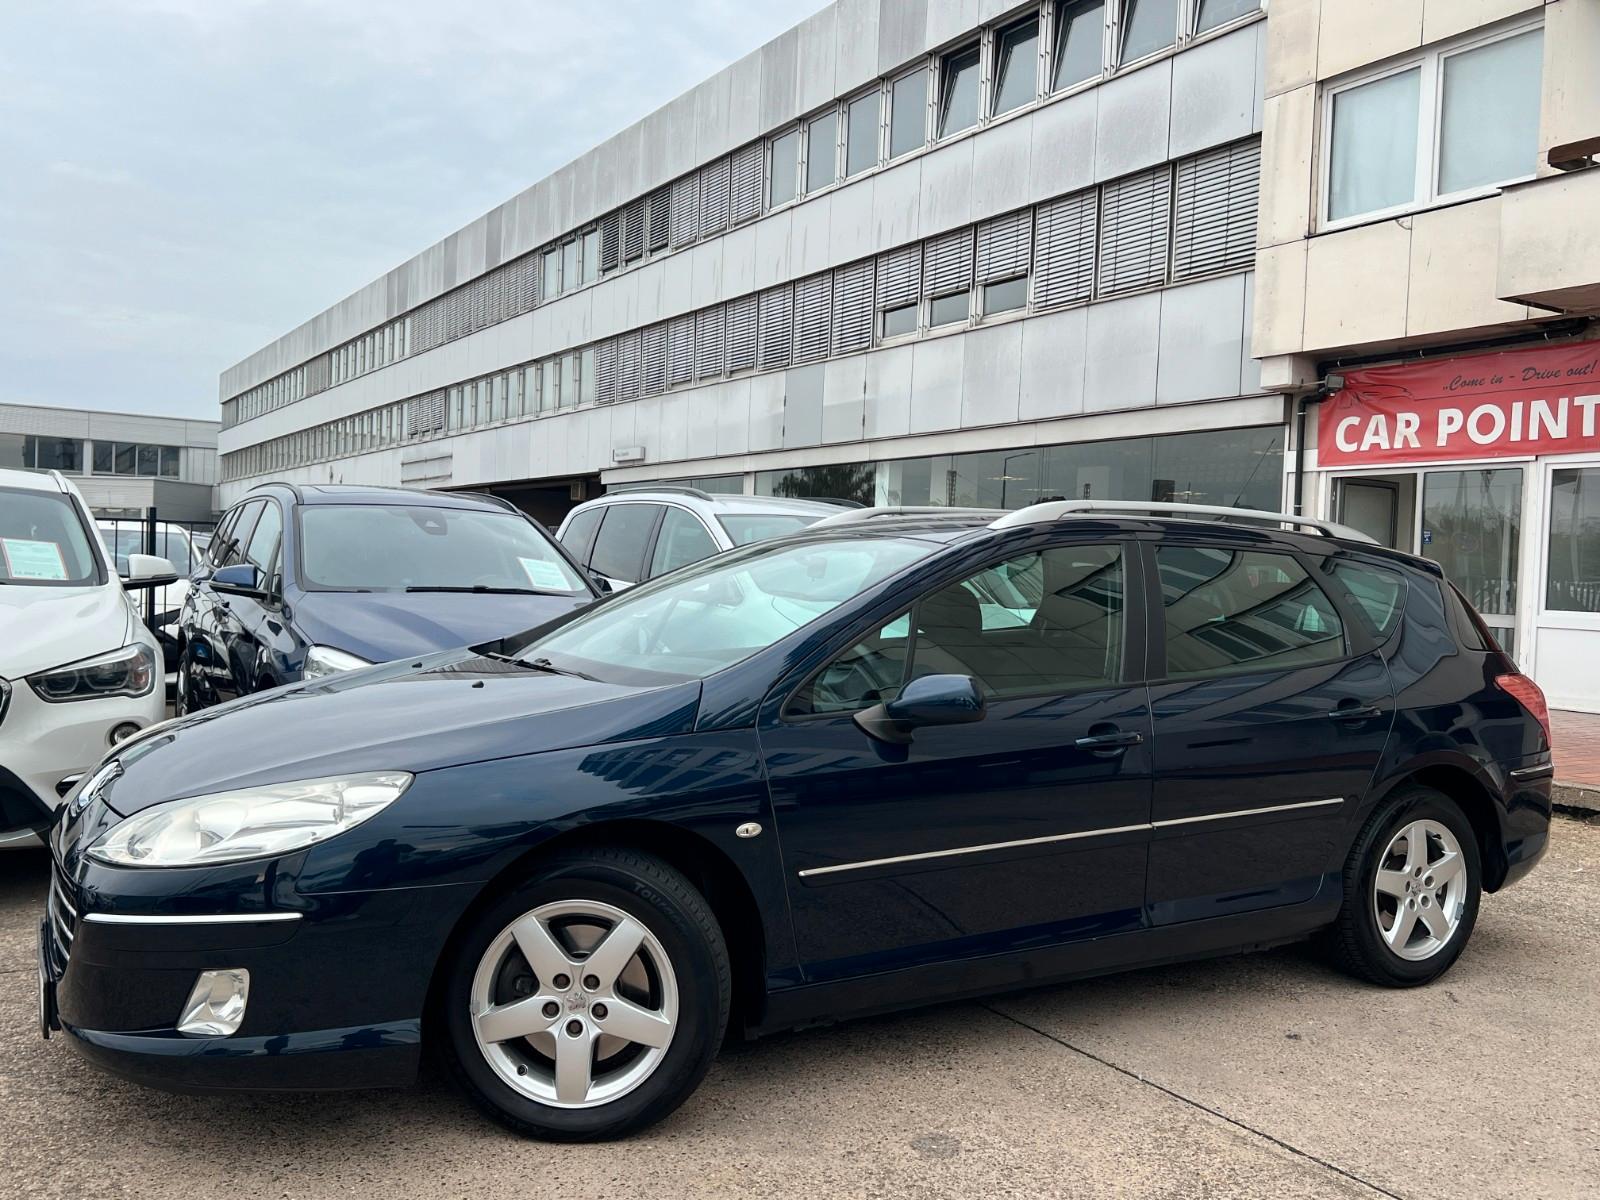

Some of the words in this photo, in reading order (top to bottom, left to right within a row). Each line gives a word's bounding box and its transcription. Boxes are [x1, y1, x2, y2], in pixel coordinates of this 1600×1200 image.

[1490, 374, 1503, 385] in
[1521, 366, 1562, 382] Drive
[1566, 361, 1599, 377] out!
[1335, 412, 1421, 453] CAR
[1436, 395, 1600, 447] POINT
